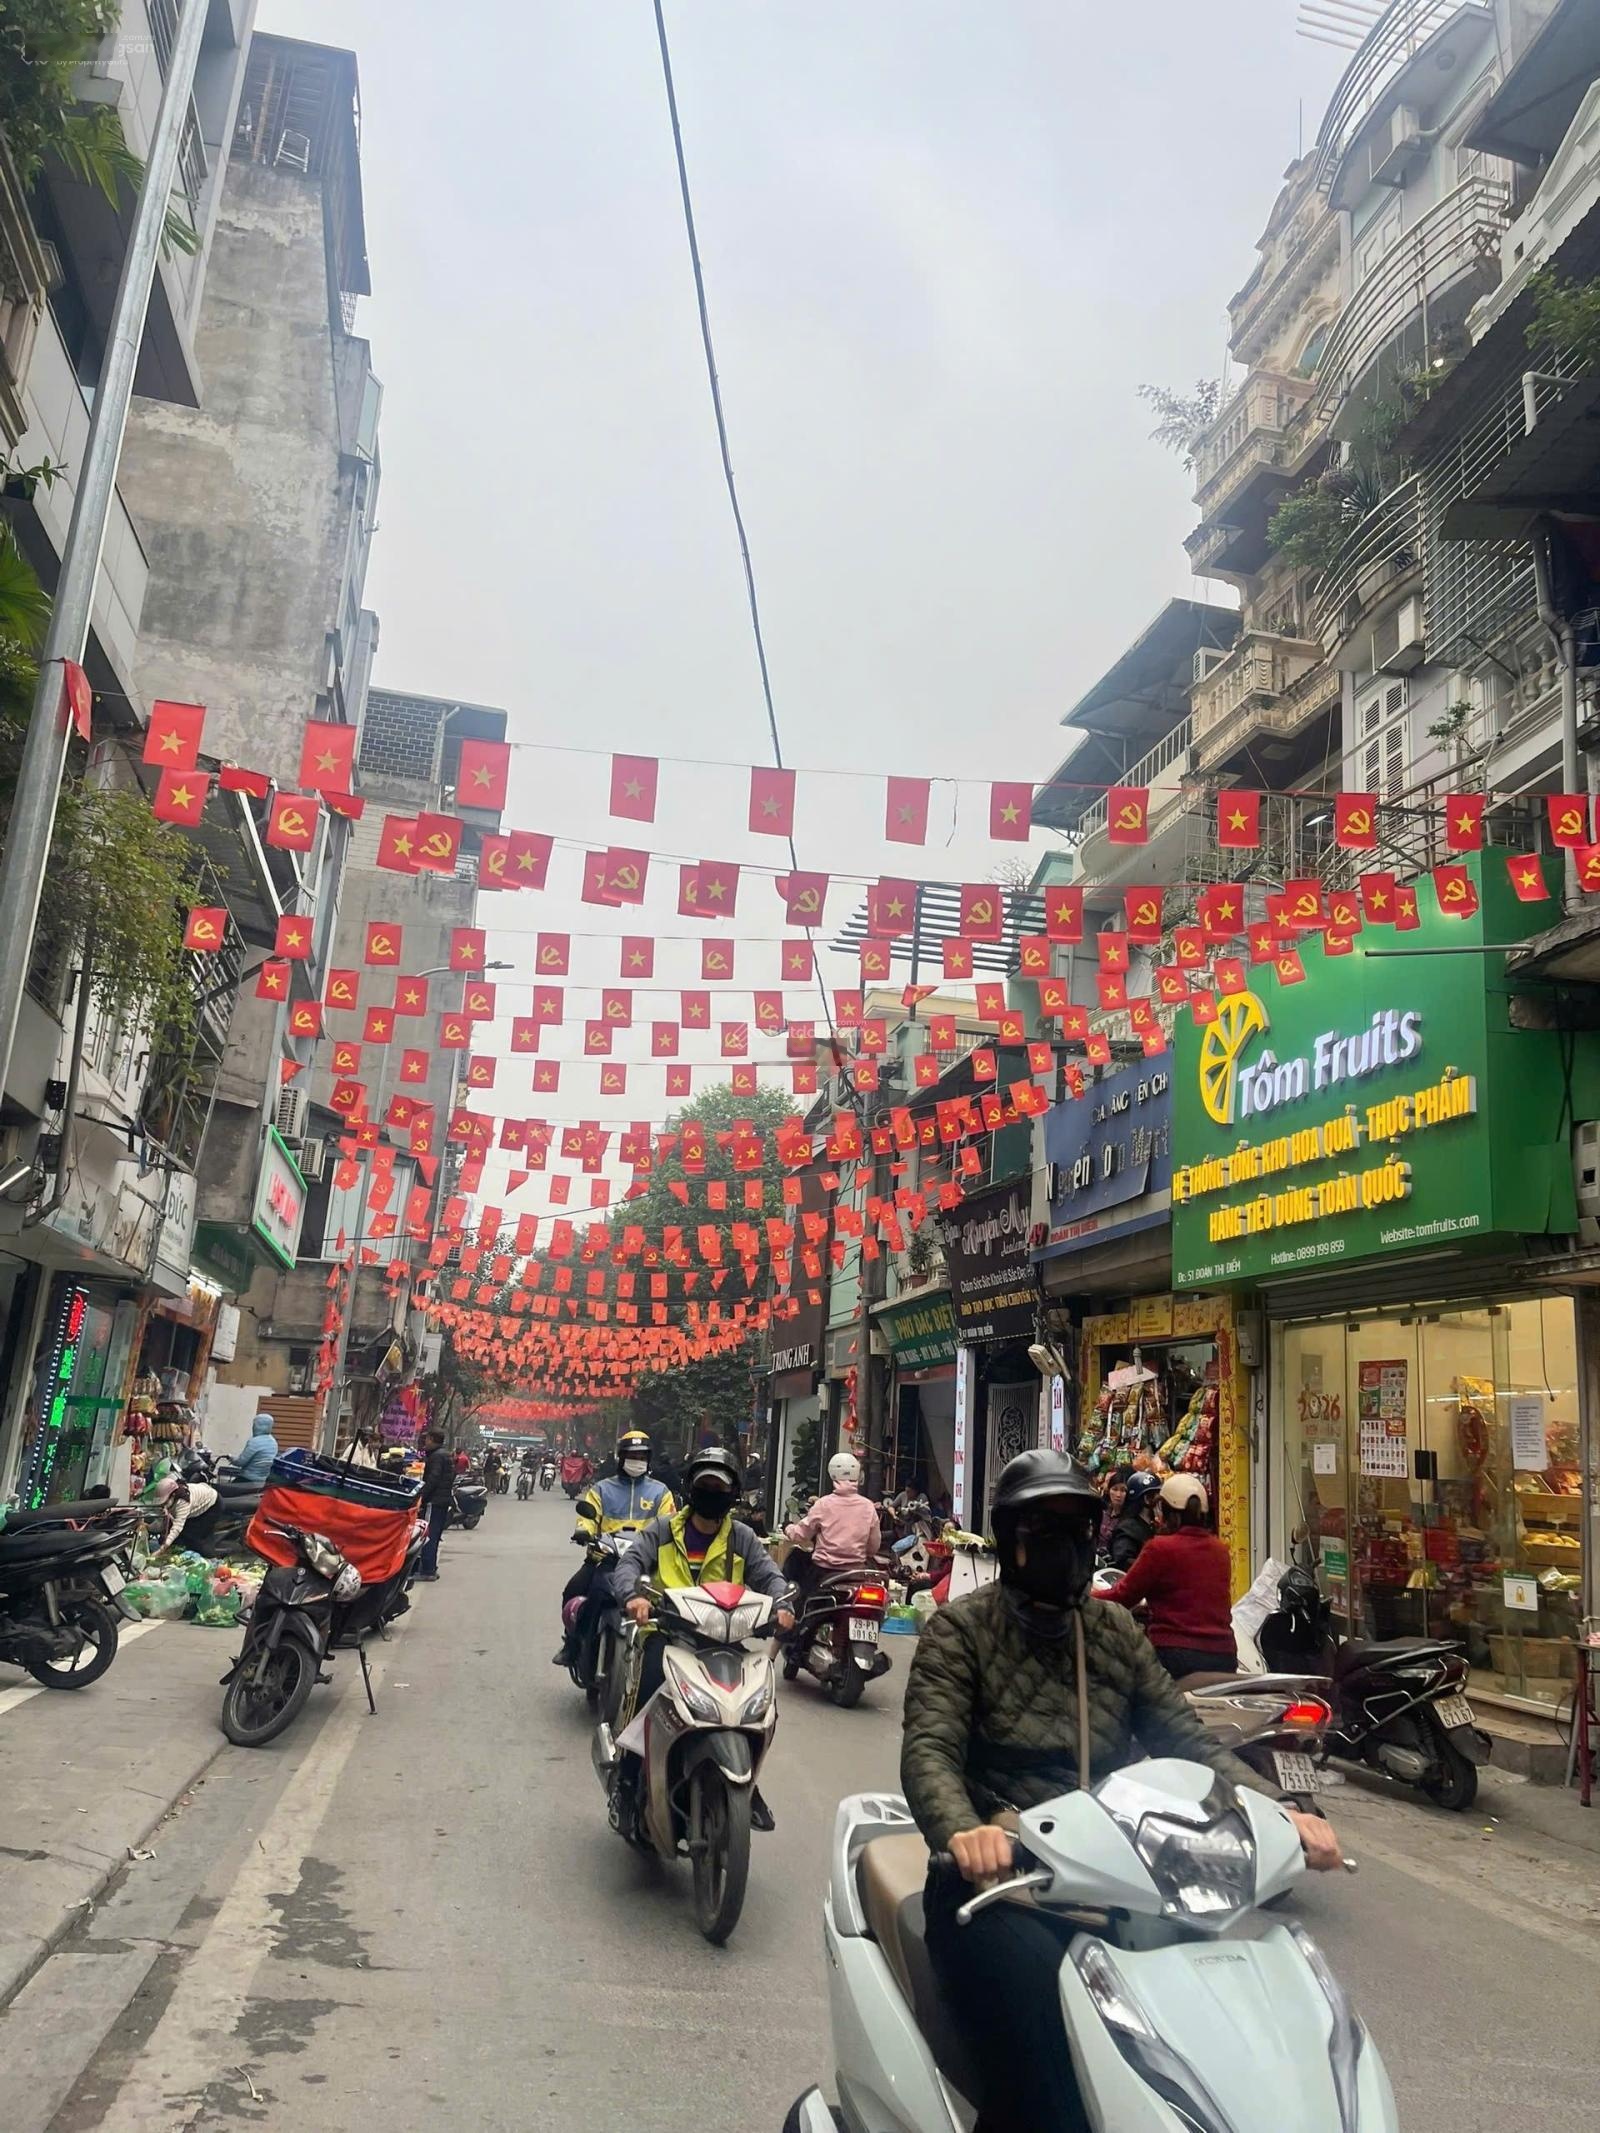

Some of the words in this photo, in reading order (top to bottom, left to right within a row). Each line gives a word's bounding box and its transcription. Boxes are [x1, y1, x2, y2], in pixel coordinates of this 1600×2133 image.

[1238, 1050, 1308, 1118] Tôm
[1314, 1009, 1421, 1090] Fruits
[1172, 1165, 1190, 1204] HỆ
[1189, 1154, 1228, 1196] THỐNG
[1227, 1140, 1261, 1184] TỔNG
[1262, 1137, 1291, 1175] KHO
[1291, 1127, 1322, 1166] HOA
[1323, 1104, 1358, 1157] QUẢ
[1366, 1095, 1413, 1143] THỰC
[1414, 1066, 1476, 1128] PHẨM
[1210, 1204, 1246, 1242] HÀNG
[1245, 1193, 1273, 1235] TIÊU
[1275, 1185, 1317, 1227] DÙNG
[1317, 1171, 1360, 1217] TOÀN
[1361, 1153, 1411, 1209] QUỐC
[1415, 1214, 1480, 1237] tomfruits.com
